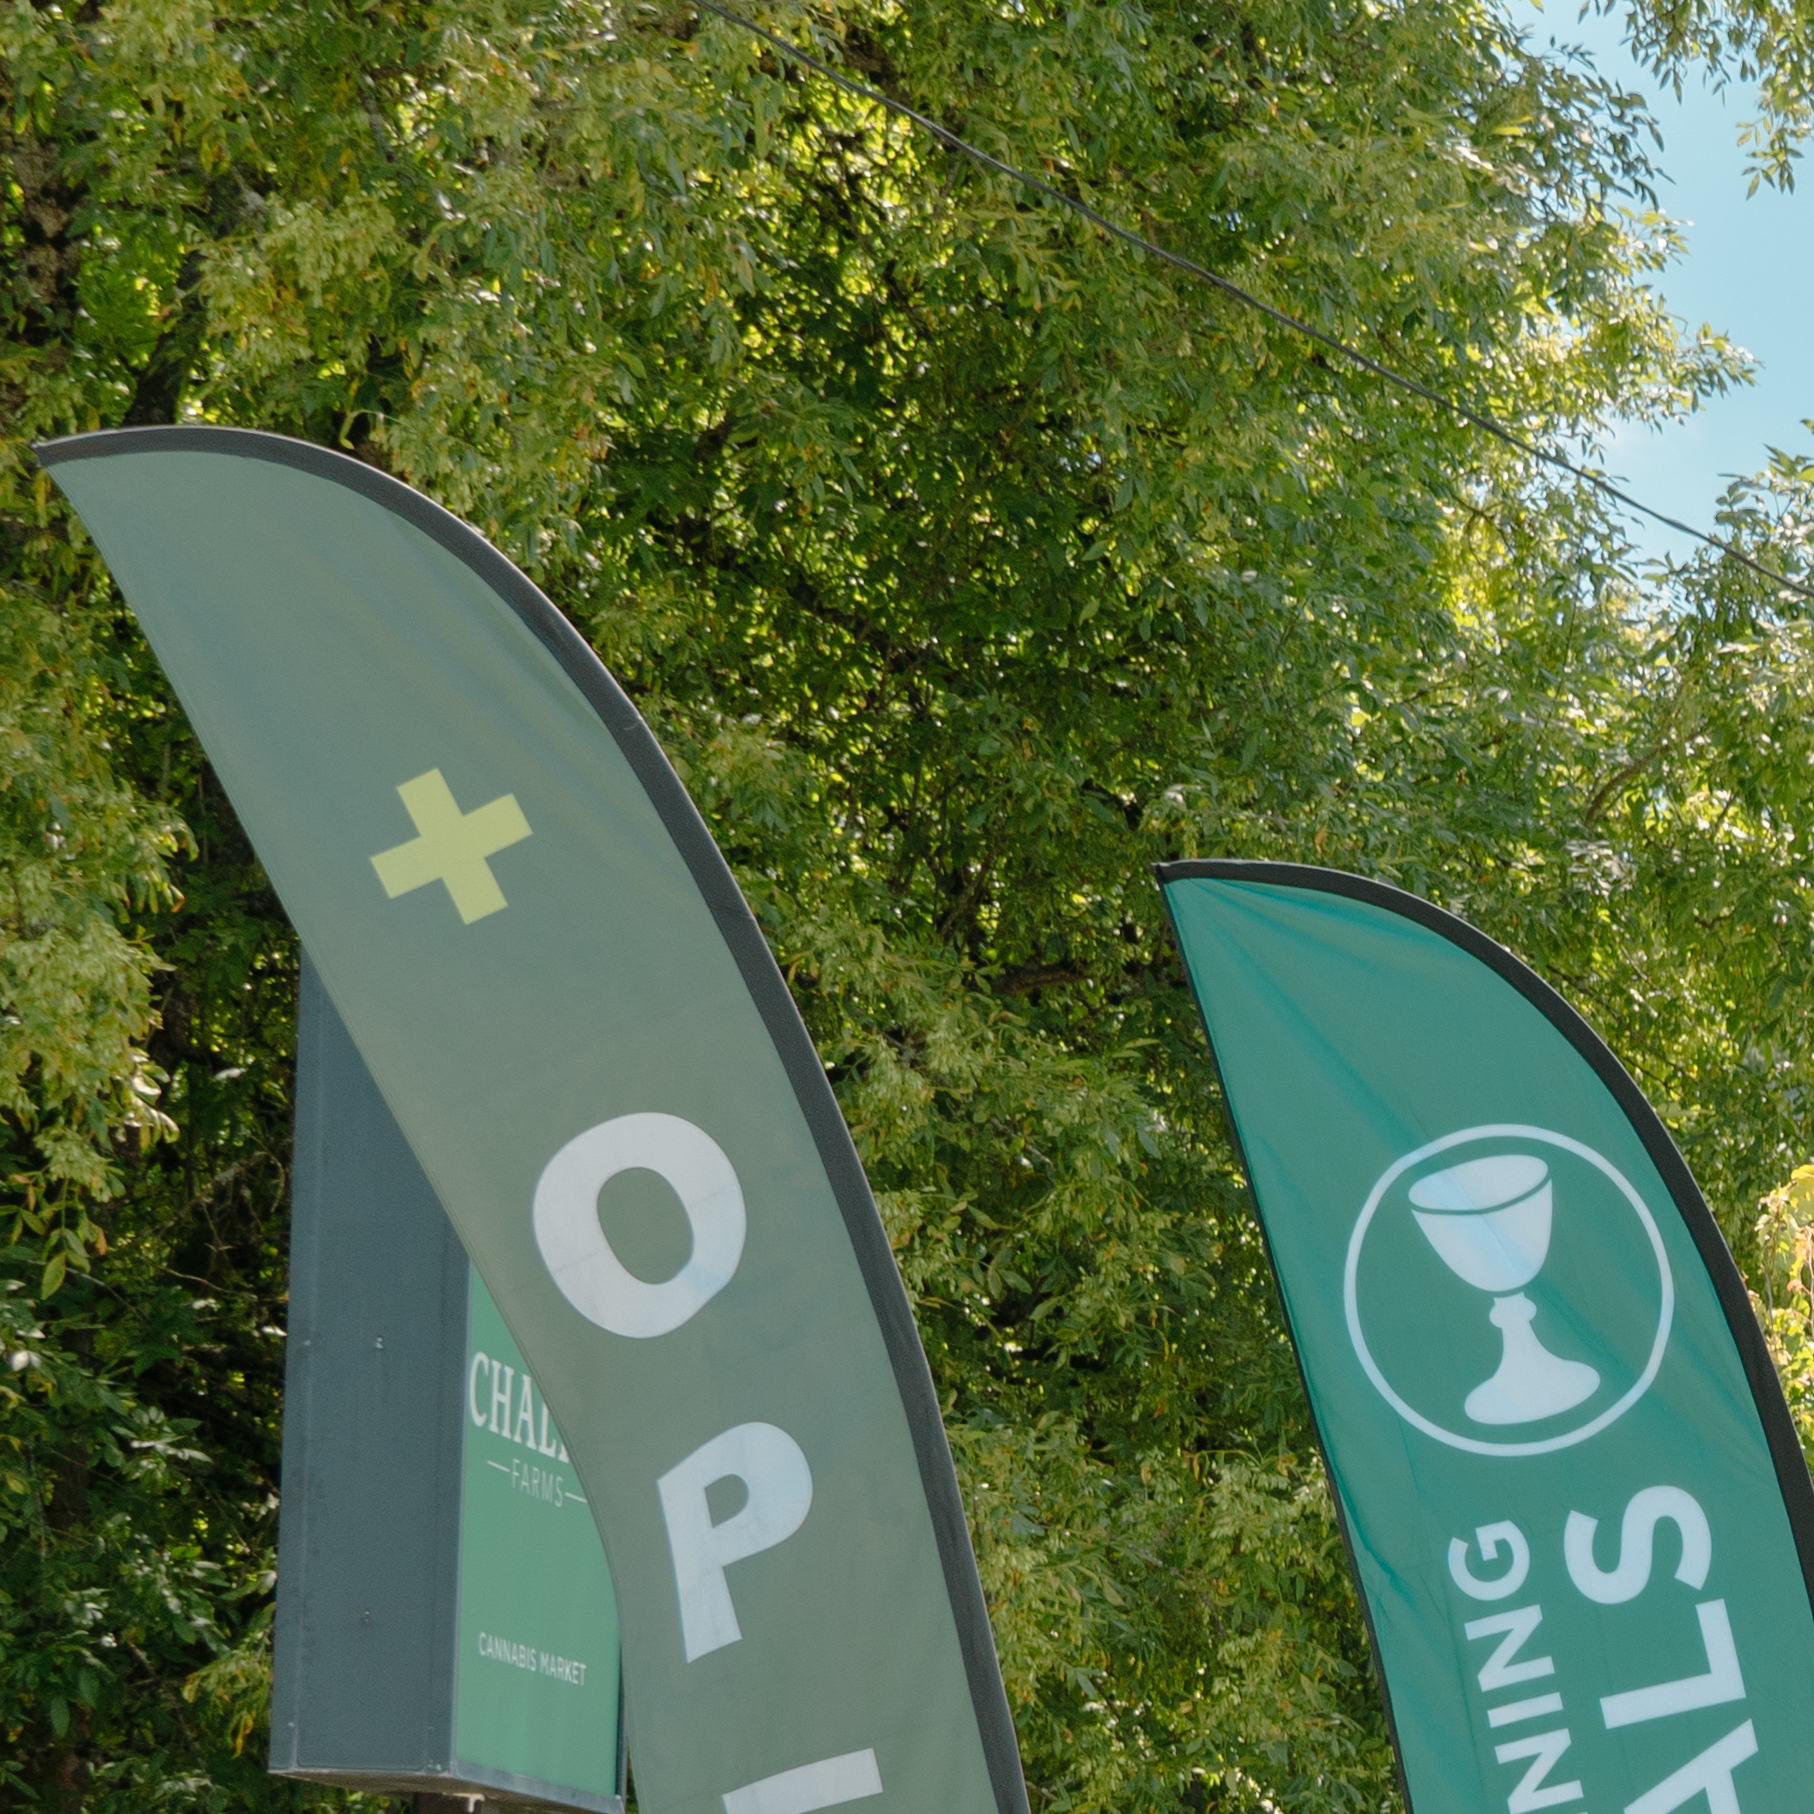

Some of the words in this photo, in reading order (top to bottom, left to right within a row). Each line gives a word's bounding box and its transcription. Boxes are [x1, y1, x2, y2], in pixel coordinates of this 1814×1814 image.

[512, 1458, 563, 1507] FARMS
[479, 1632, 536, 1671] CANNABIS
[541, 1651, 587, 1685] MARKET
